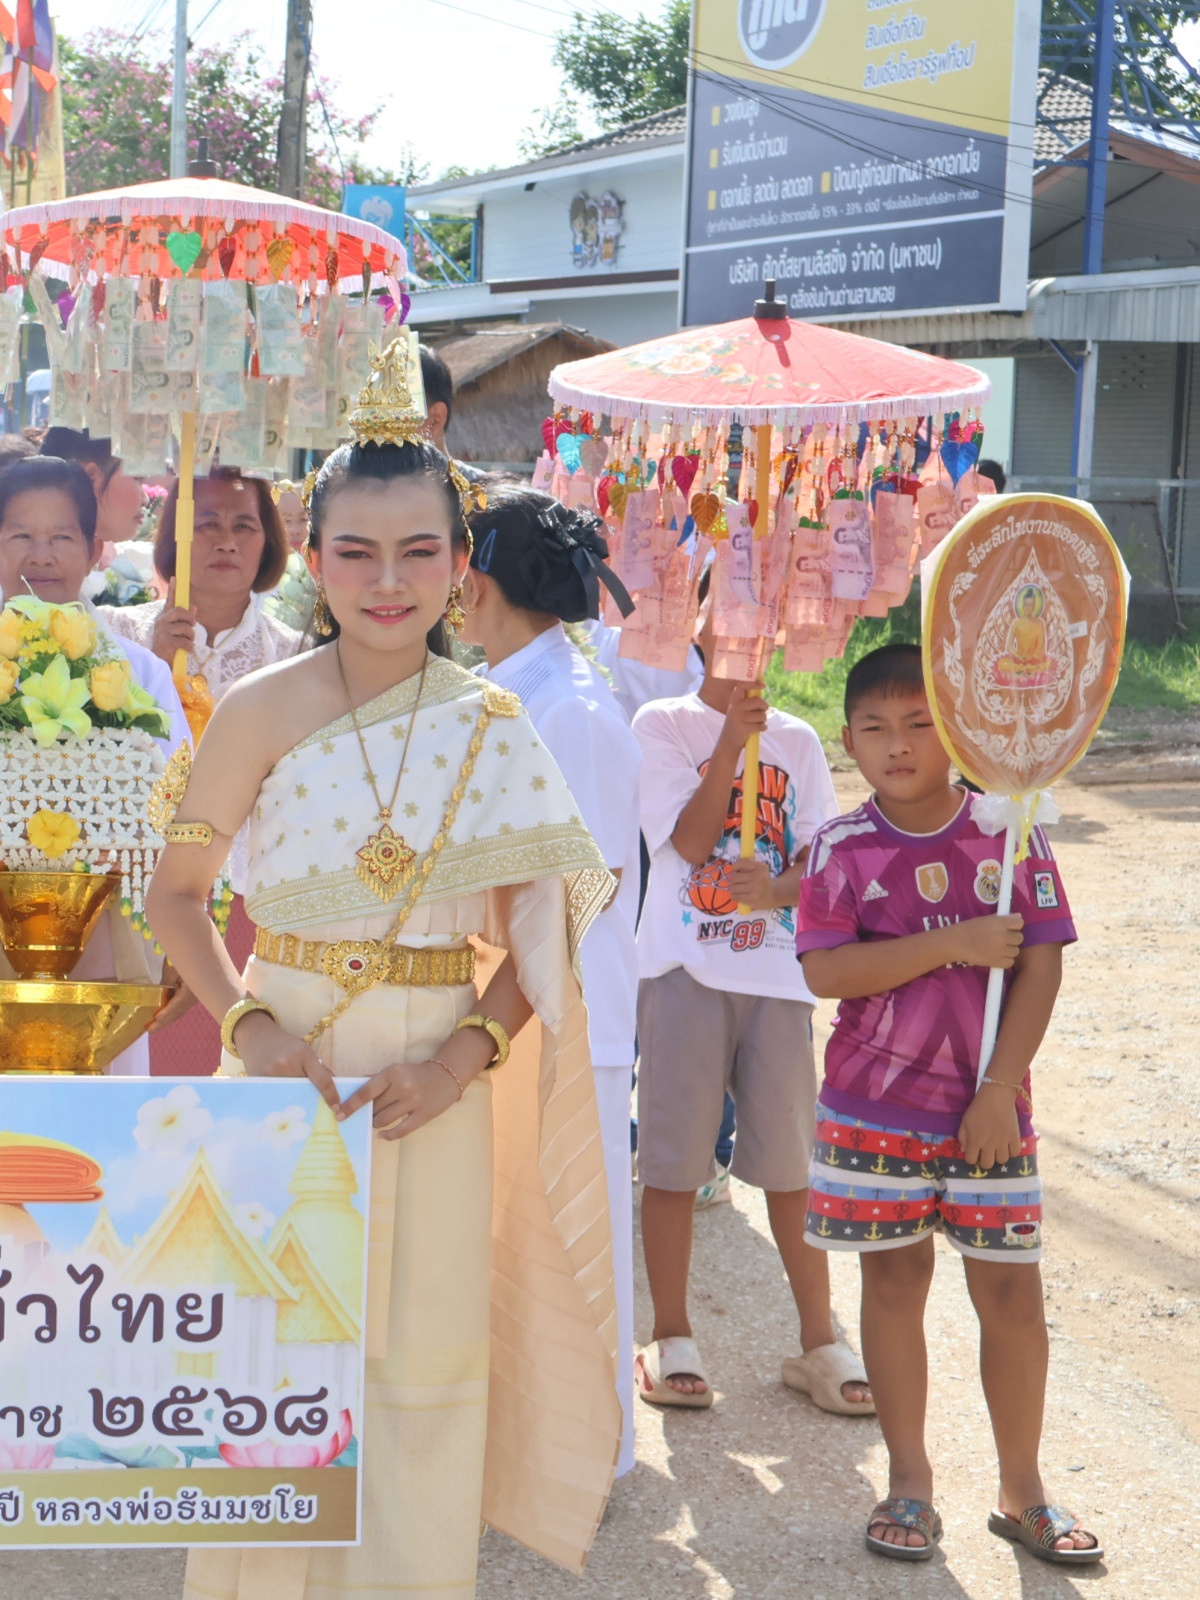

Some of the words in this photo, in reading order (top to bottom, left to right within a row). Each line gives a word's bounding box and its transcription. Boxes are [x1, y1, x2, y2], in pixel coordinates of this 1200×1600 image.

[865, 10, 927, 50] สินเชื่อที่ดิน
[729, 256, 759, 284] บริษัท
[762, 240, 847, 281] ศักดิ์สยามลิสซิ่ง
[851, 242, 885, 273] จำกัด
[889, 237, 942, 273] (มหาชน)
[697, 919, 733, 941] NYC
[730, 918, 766, 952] 99
[87, 1385, 330, 1438] ๒๕๖๘
[36, 1487, 318, 1525] หลวงพ่อธัมมชโย
